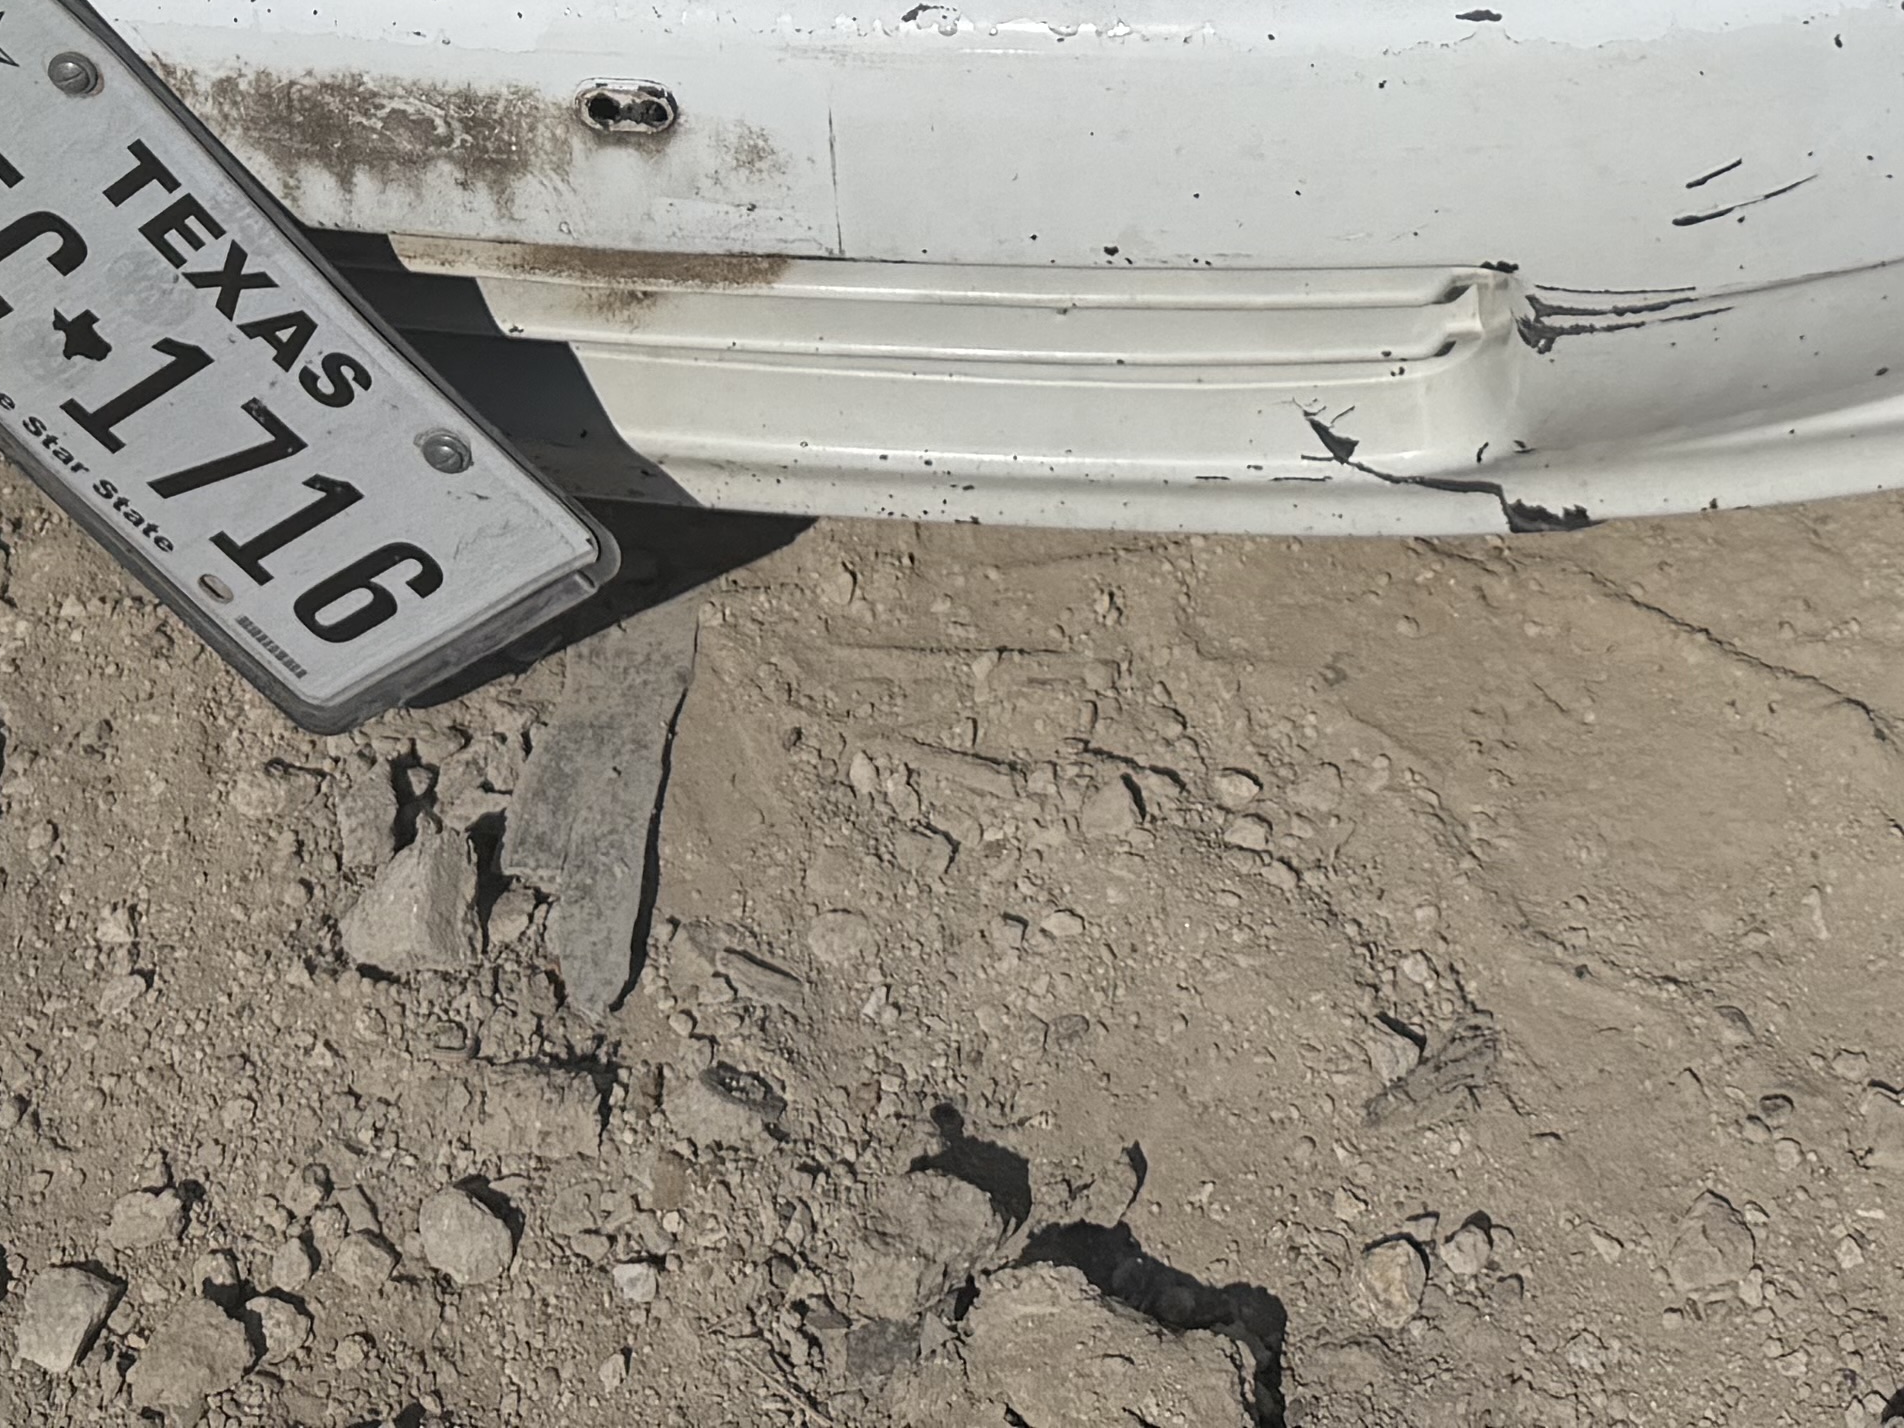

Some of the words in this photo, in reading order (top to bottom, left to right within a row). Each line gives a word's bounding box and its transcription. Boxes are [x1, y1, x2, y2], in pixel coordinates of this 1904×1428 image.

[101, 139, 371, 408] TEXAS
[21, 415, 91, 474] Star
[92, 478, 175, 553] State
[59, 336, 444, 643] 1716
